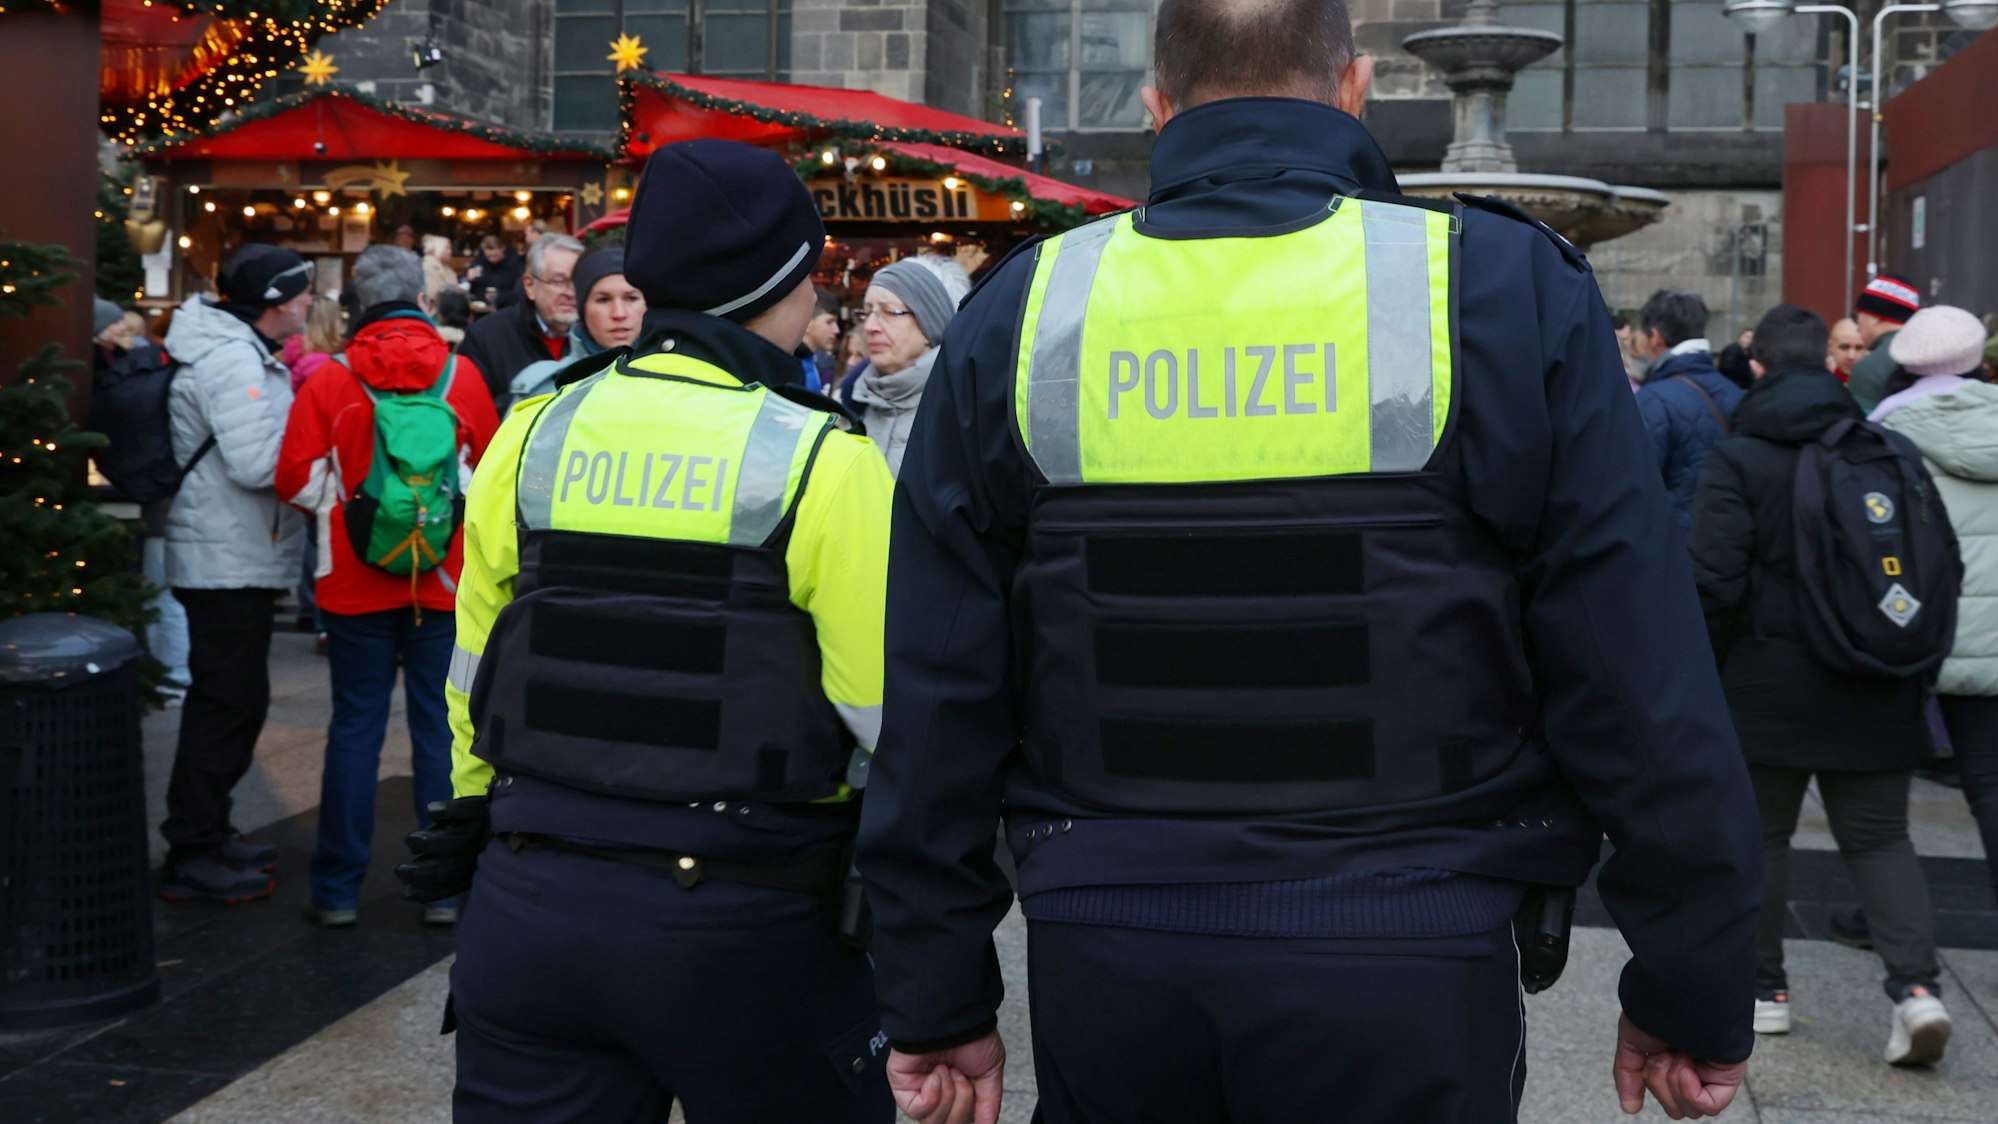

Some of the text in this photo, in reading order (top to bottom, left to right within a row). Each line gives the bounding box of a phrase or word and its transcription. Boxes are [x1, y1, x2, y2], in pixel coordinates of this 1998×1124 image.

[814, 183, 967, 218] ckhüsli
[1108, 342, 1337, 420] POLIZEI
[560, 450, 729, 512] POLIZEI
